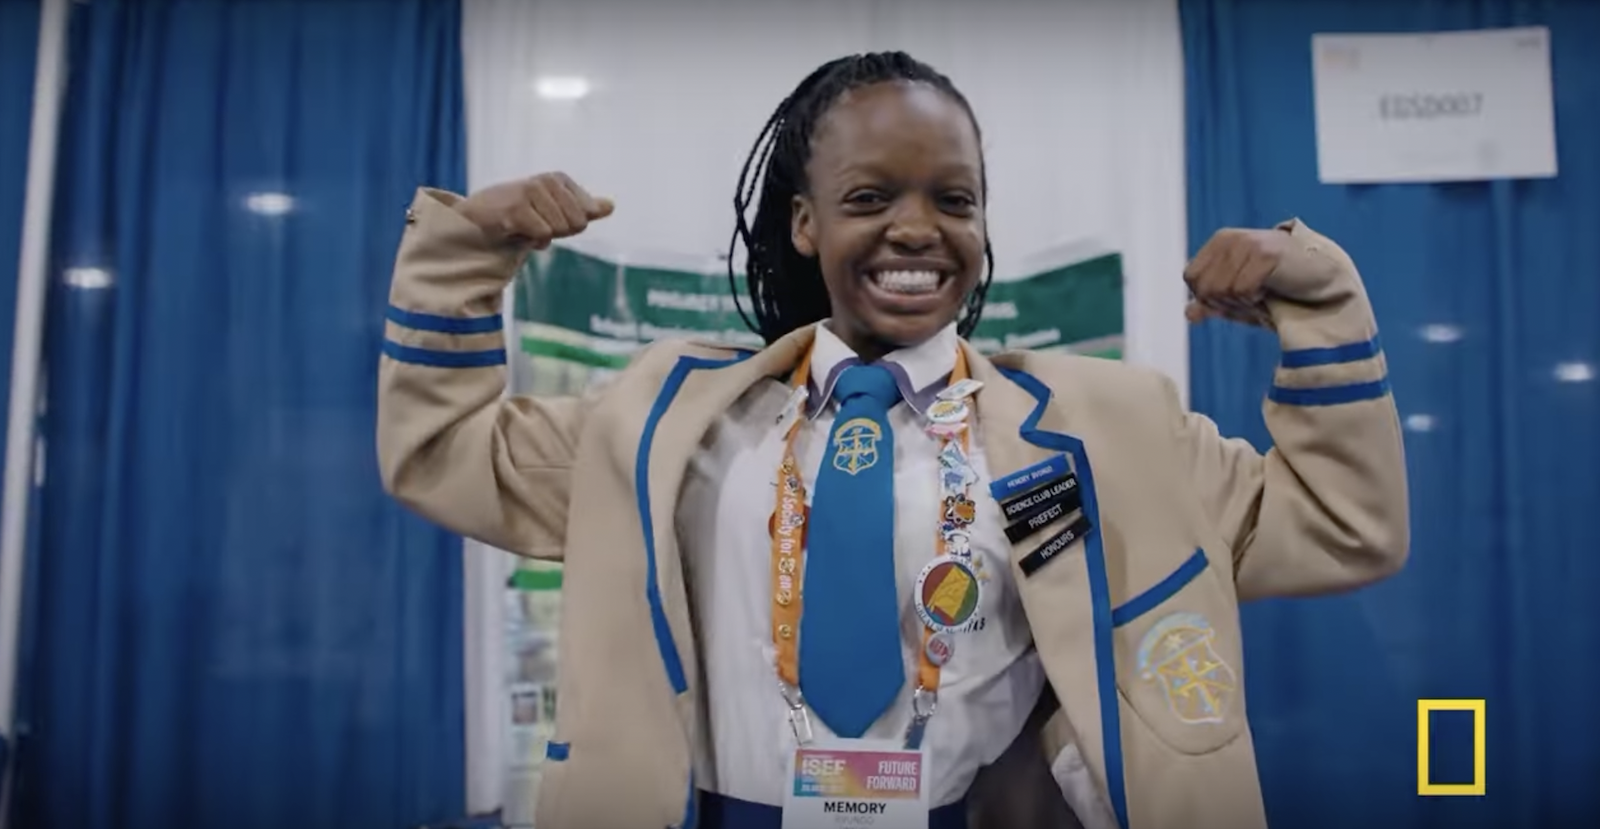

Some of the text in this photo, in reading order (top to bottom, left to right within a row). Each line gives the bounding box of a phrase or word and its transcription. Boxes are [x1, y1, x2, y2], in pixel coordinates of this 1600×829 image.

[1007, 474, 1030, 488] MEMORY
[1006, 478, 1077, 515] SCIENCE CLUB LEADER
[1028, 503, 1063, 529] PREFECT
[1040, 529, 1075, 560] HONOURS
[802, 759, 846, 776] ISEF
[878, 760, 918, 776] FUTURE
[866, 775, 917, 791] FORWARD
[824, 801, 887, 814] MEMORY
